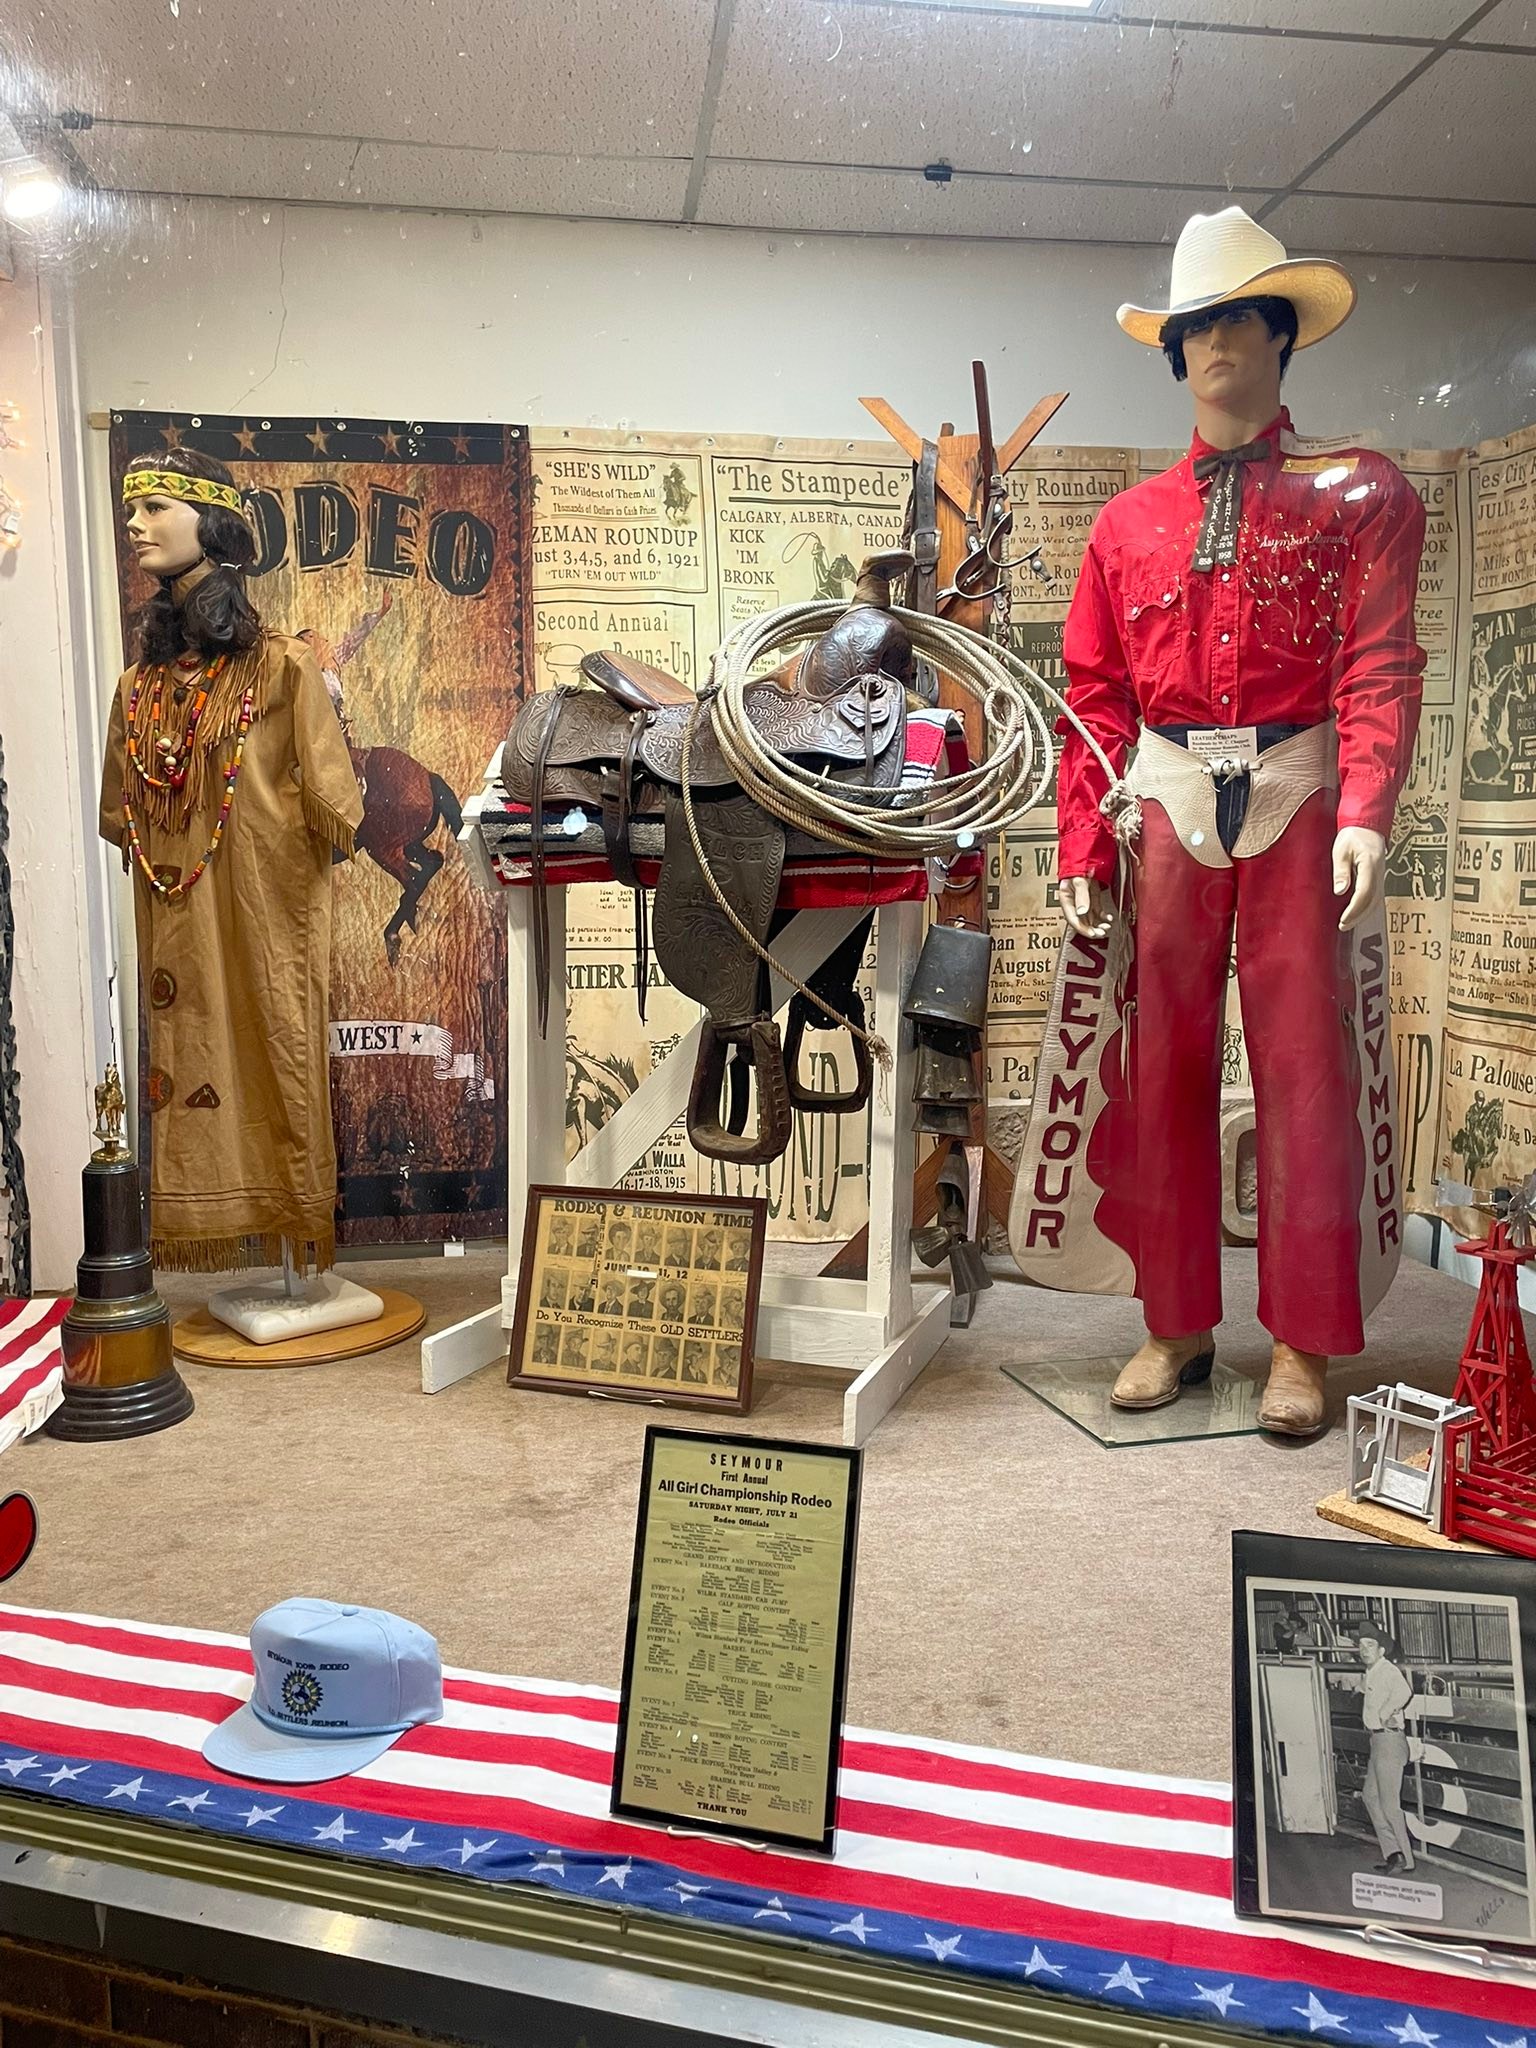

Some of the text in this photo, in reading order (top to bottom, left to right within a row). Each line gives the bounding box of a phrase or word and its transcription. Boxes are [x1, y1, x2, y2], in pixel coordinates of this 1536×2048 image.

[551, 486, 655, 498] The Wildest of Them All
[1005, 477, 1120, 501] ity Roundup
[720, 511, 902, 527] CALGARY, ALBERTA, CANAD
[1024, 514, 1092, 531] 2, 3, 1920
[240, 482, 497, 597] ODEO
[532, 526, 697, 547] ZEMAN ROUNDUP
[729, 529, 765, 543] KICK
[1260, 535, 1310, 553] Seymour
[535, 549, 558, 563] ust
[613, 549, 642, 565] and
[648, 550, 661, 566] 6,
[668, 553, 699, 568] 1921
[605, 571, 626, 581] OUT
[724, 569, 775, 584] BRONK
[1013, 586, 1040, 598] ONT.,
[1418, 579, 1444, 592] OW
[537, 611, 668, 632] Second Annual
[1390, 913, 1431, 934] EPT.
[1503, 930, 1536, 949] Roun
[993, 958, 1051, 976] August
[1471, 952, 1520, 975] August
[337, 1026, 404, 1051] WEST
[1470, 1055, 1536, 1095] Palouse
[1025, 933, 1109, 1248] SEYMOUR
[1361, 933, 1399, 1256] SEYMOUR
[666, 1177, 686, 1188] 1915
[554, 1200, 607, 1216] RODEO
[613, 1205, 625, 1216] &
[632, 1206, 706, 1225] REUNION
[676, 1270, 688, 1279] 12
[536, 1310, 745, 1342] Do You Recognize These OLD SETTLERS
[711, 1453, 783, 1471] SEYMOUR
[721, 1472, 768, 1485] First Annual
[659, 1480, 832, 1508] All Girl Championship Rodeo
[689, 1501, 731, 1512] SATURDAY
[735, 1506, 763, 1515] NIGHT,
[767, 1509, 786, 1518] JULY
[714, 1516, 769, 1528] Rodeo Officials
[319, 1663, 349, 1671] RODEO
[697, 1802, 747, 1816] THANK YOU
